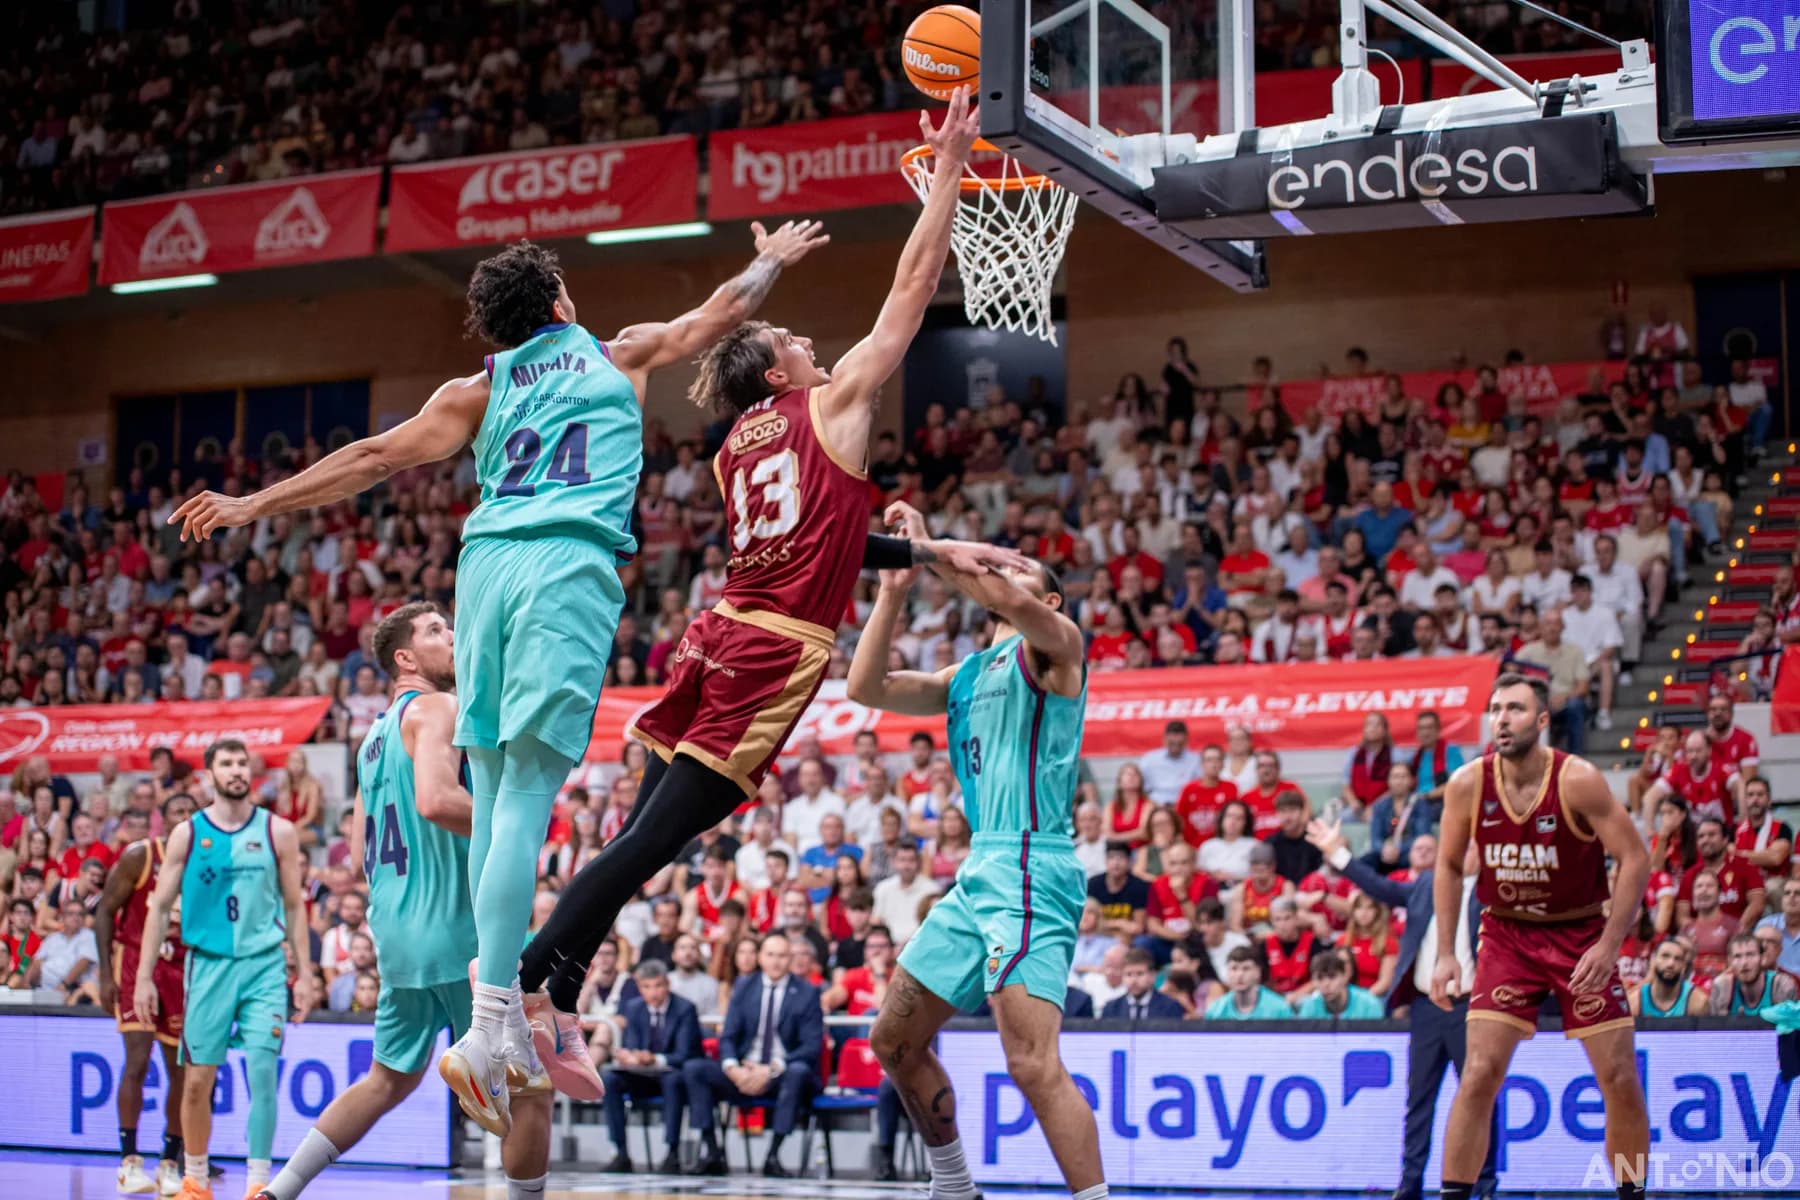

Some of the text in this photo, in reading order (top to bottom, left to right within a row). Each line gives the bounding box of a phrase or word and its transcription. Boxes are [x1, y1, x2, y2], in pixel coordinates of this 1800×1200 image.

[905, 46, 960, 76] Wilson
[489, 150, 625, 203] caser
[1267, 139, 1538, 210] endesa
[456, 215, 527, 241] Grupo
[496, 421, 591, 498] 24
[732, 447, 800, 553] 13
[1291, 685, 1470, 718] LEVANTE
[961, 735, 982, 779] 13
[1484, 842, 1560, 871] UCAM
[1495, 867, 1551, 883] MURCIA
[225, 894, 240, 923] 8
[1496, 1048, 1800, 1173] pelay
